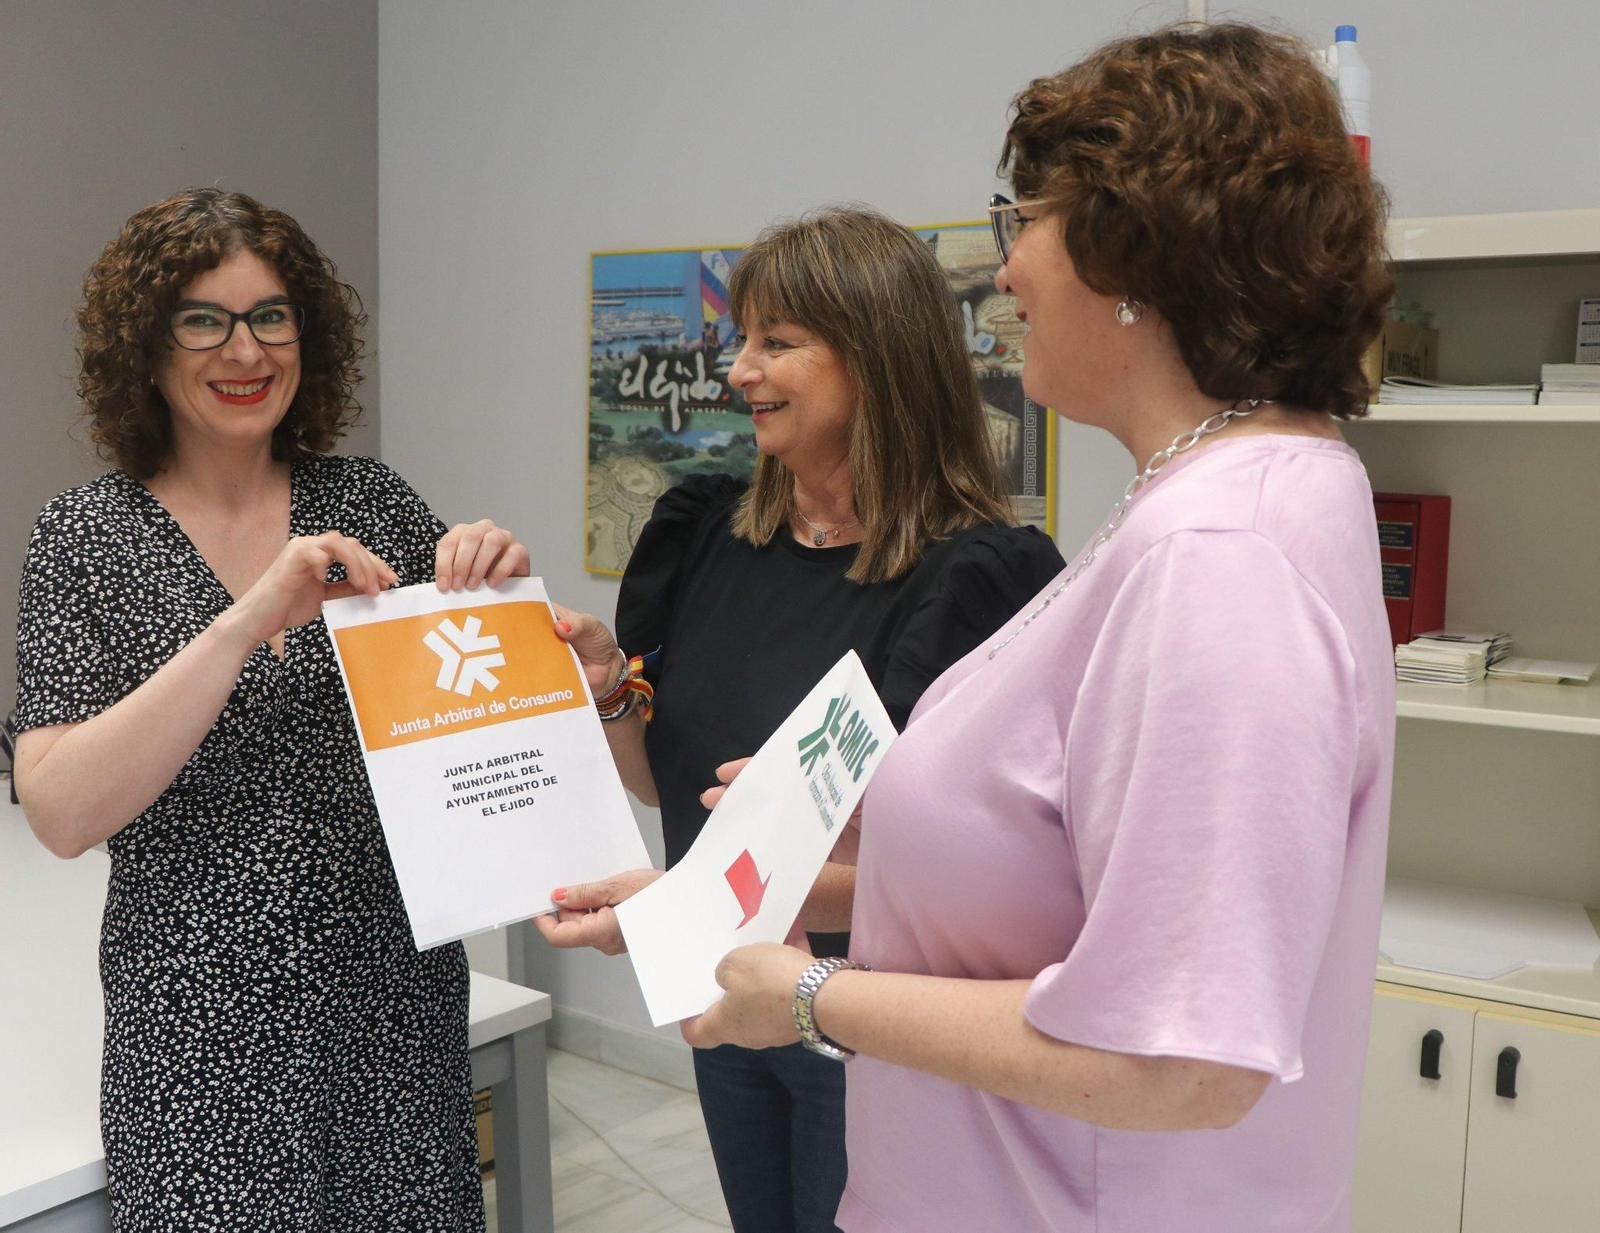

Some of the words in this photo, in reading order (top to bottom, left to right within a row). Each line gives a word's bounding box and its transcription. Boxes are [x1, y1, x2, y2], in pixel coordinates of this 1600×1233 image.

[390, 717, 430, 736] Junta
[434, 703, 486, 727] Arbitral
[489, 700, 507, 714] de
[509, 689, 573, 710] Consumo
[837, 710, 879, 783] OMIC
[443, 762, 483, 778] JUNTA
[487, 749, 544, 769] ARBITRAL
[452, 769, 518, 792] MUNICIPAL
[521, 764, 543, 776] DEL
[446, 780, 540, 809] AYUNTAMIENTO
[543, 776, 558, 787] DE
[482, 806, 497, 817] EL
[500, 797, 534, 812] EJIDO
